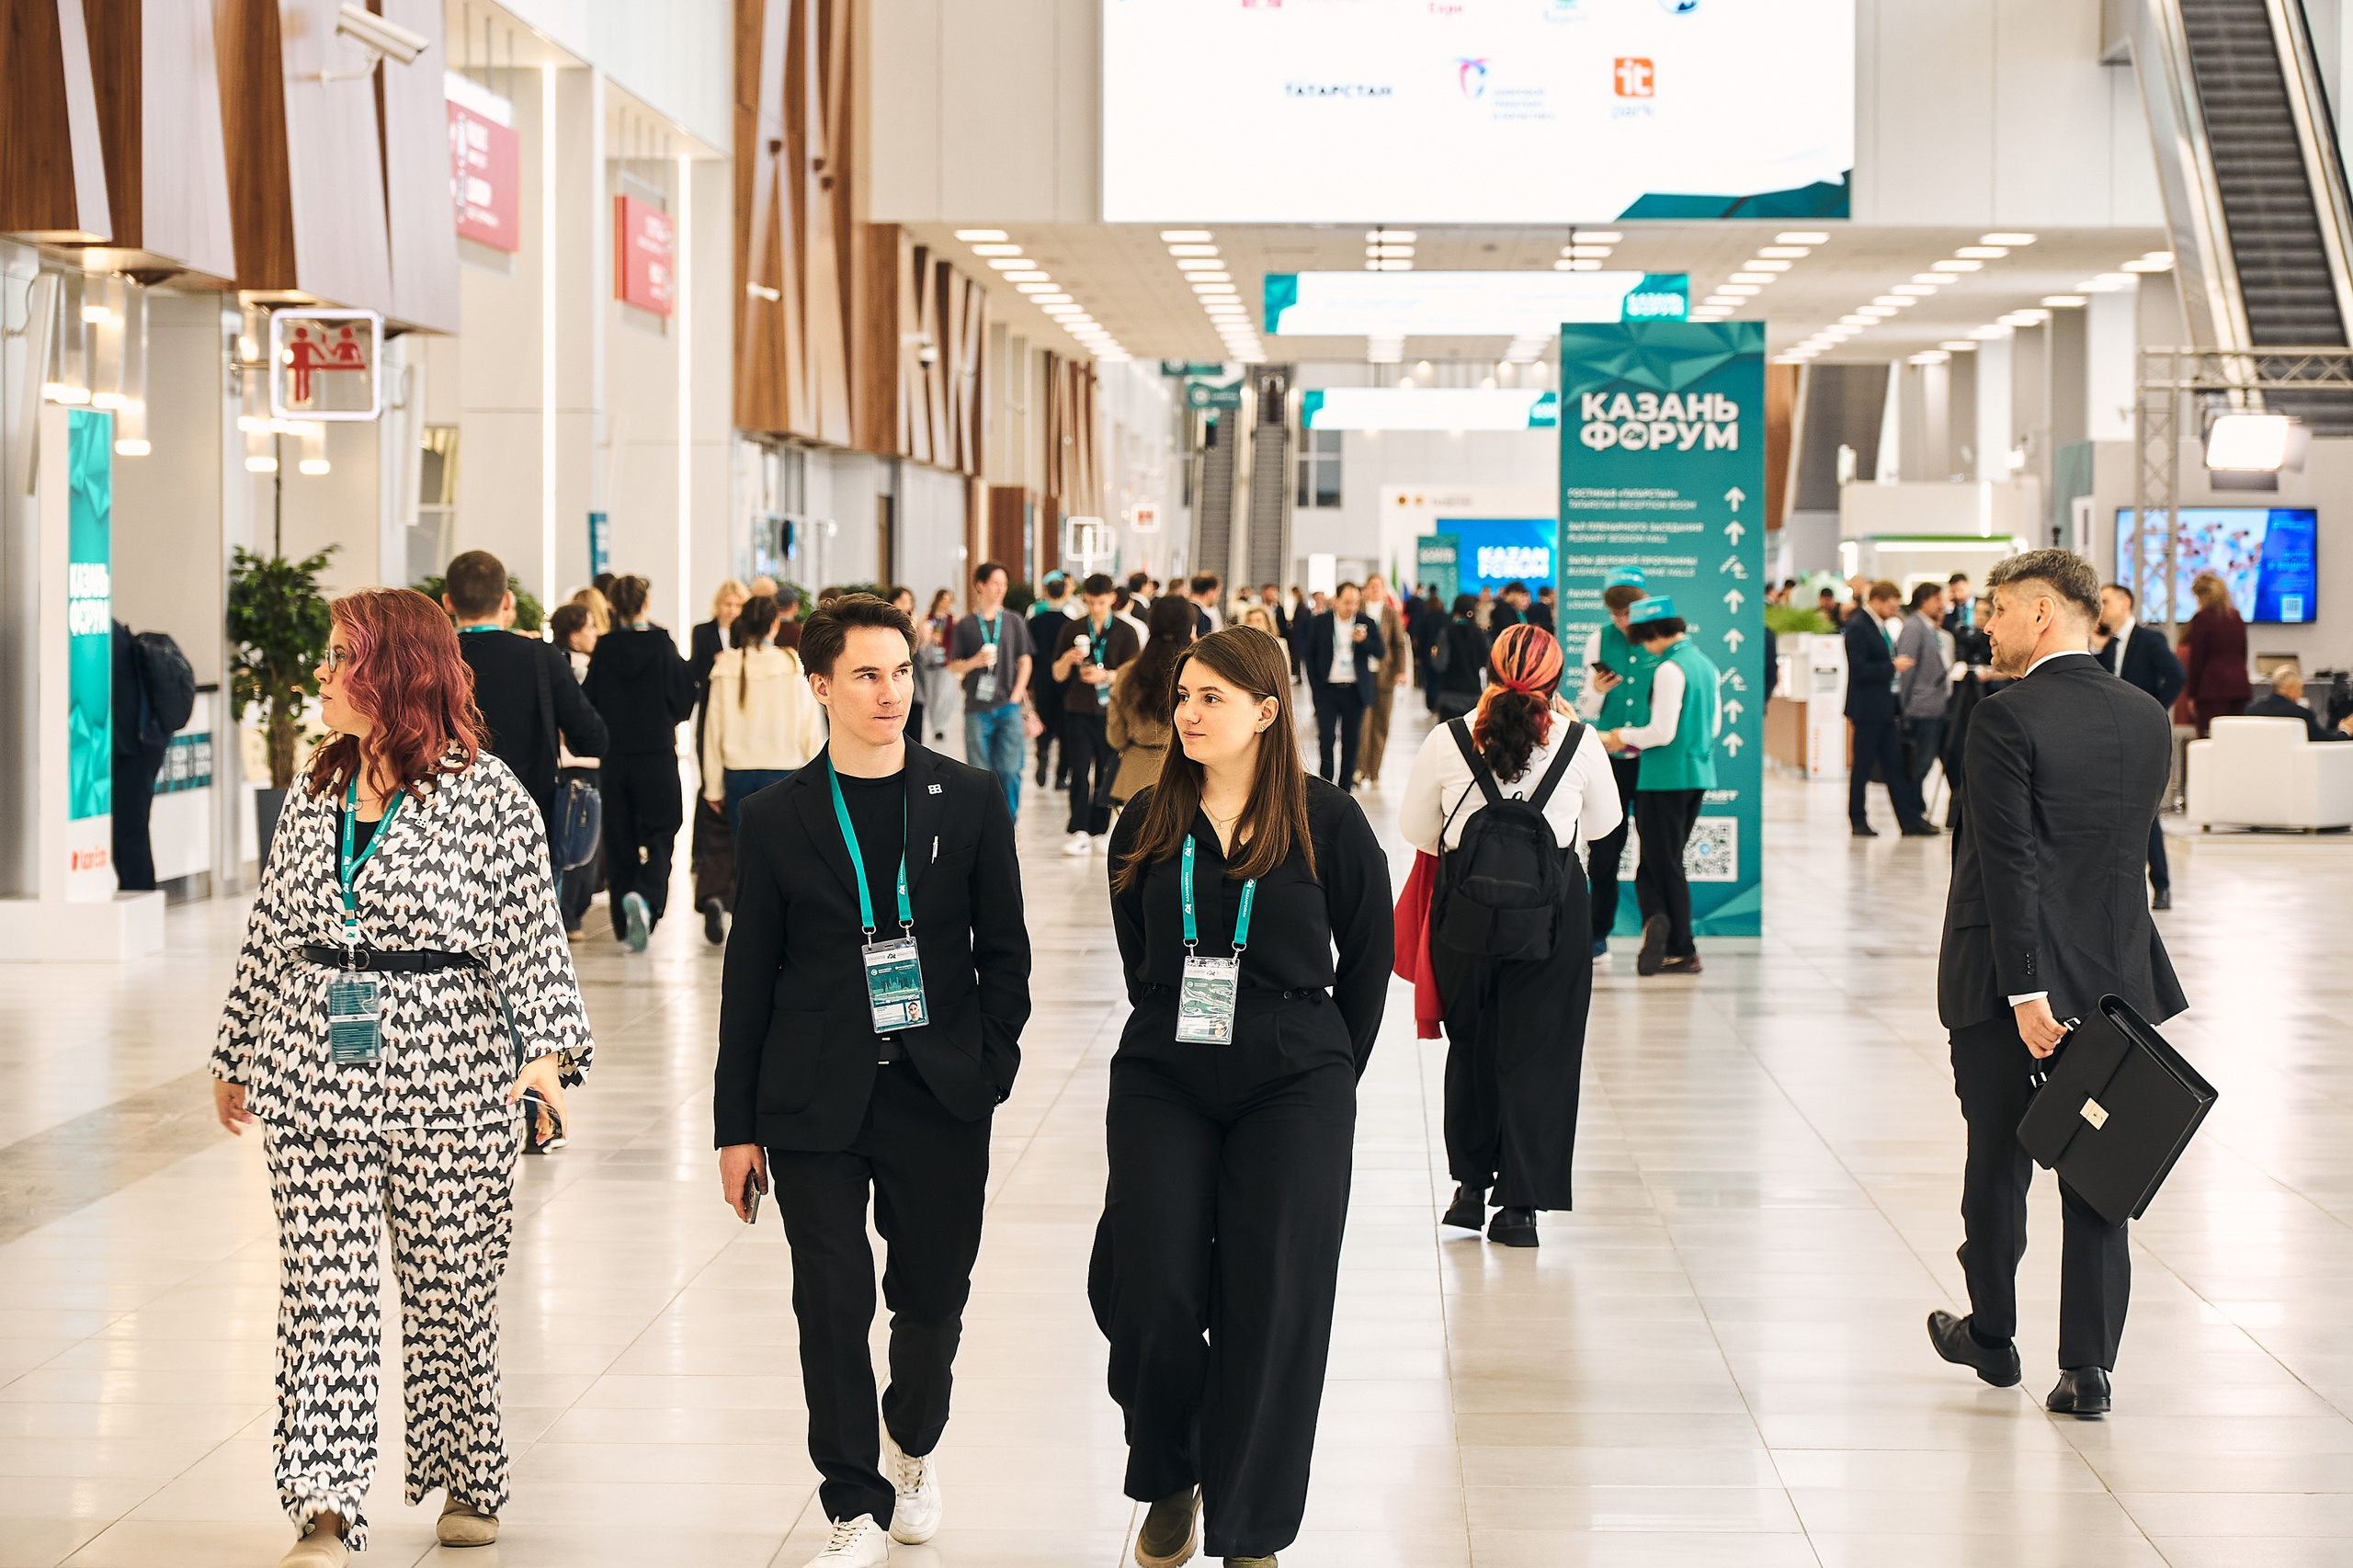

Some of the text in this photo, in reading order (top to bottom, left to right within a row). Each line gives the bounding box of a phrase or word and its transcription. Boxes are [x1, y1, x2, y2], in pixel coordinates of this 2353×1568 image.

[1580, 392, 1739, 422] КАЗАНЬ
[1580, 421, 1739, 450] ФОРУМ
[69, 562, 109, 598] КАЗАНЬ
